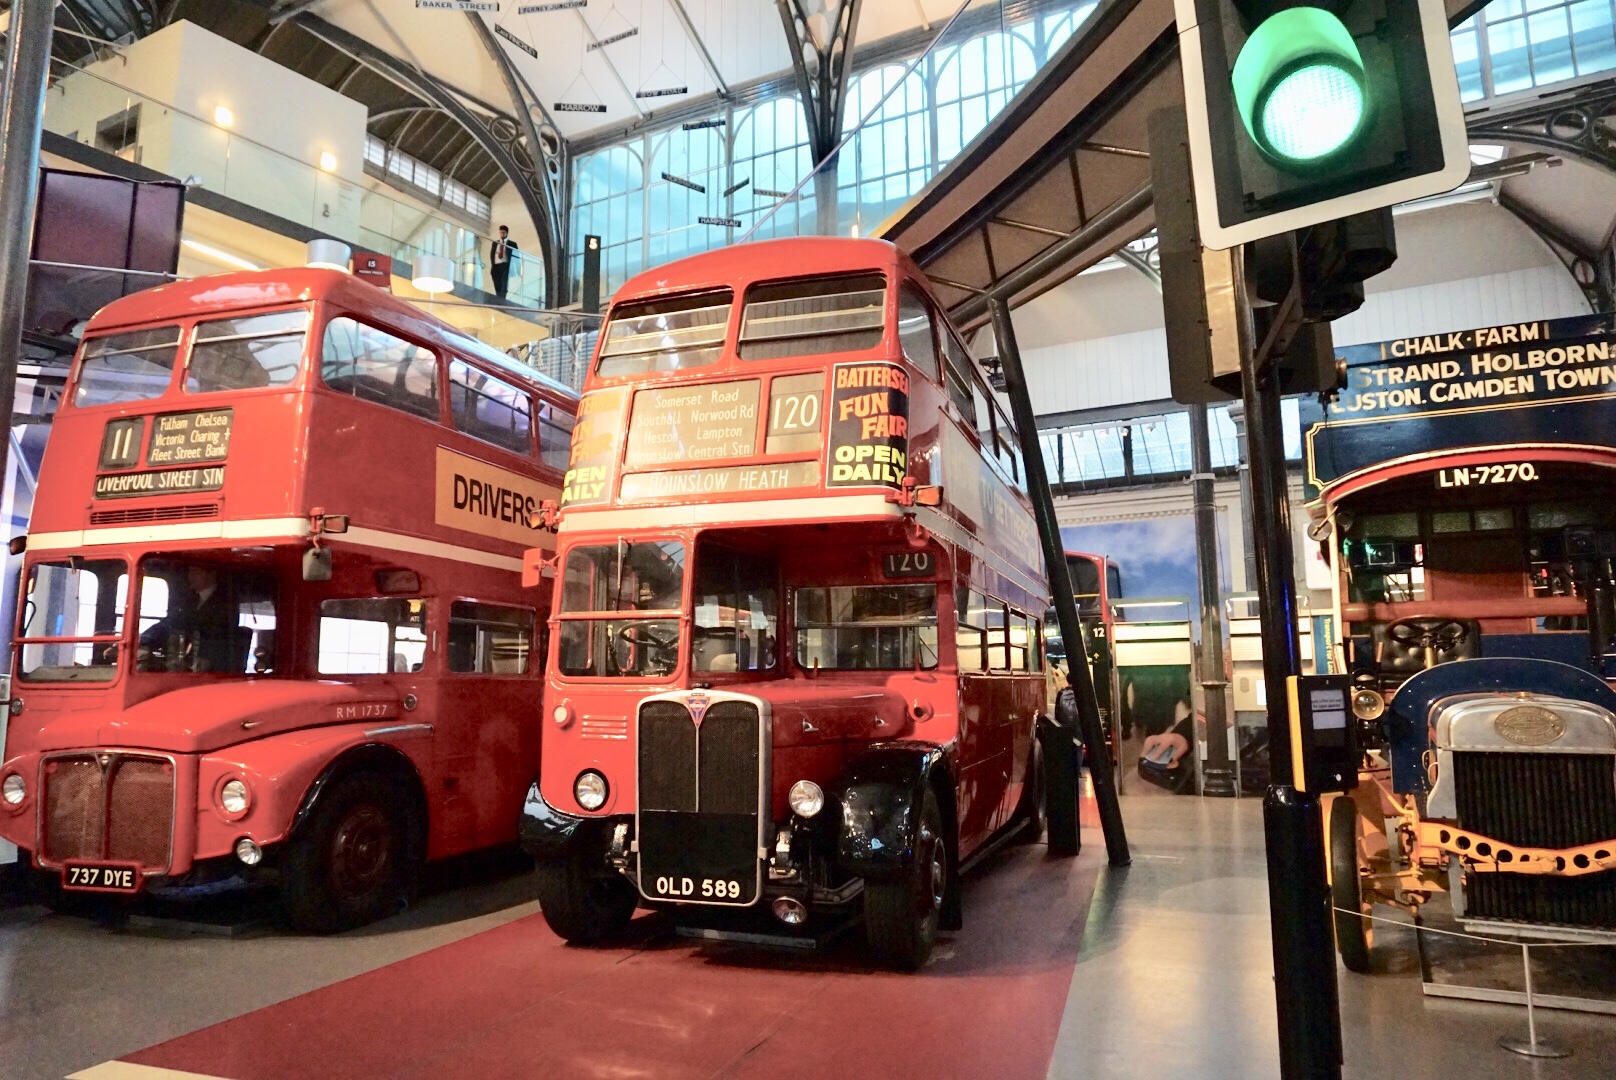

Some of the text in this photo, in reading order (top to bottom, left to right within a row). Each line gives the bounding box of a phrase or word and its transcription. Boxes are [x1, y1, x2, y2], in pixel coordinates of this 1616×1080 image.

[422, 0, 492, 10] BAKER STREET
[550, 0, 584, 10] JUNCTION
[661, 88, 683, 96] ROAD
[560, 103, 600, 112] HARROW
[700, 217, 739, 227] HAMPSTEAD
[589, 238, 598, 250] 5
[368, 260, 376, 268] 15
[1391, 322, 1539, 357] CHALK FARM
[1358, 341, 1616, 388] STRAND. HOLBORN.
[1430, 375, 1534, 402] CAMDEN
[1541, 364, 1616, 391] TOWN
[655, 388, 740, 409] Somerset Road
[839, 392, 889, 422] FUN
[637, 404, 754, 427] Southall Norwood Rd
[773, 394, 818, 430] 120
[160, 414, 227, 431] Fulham Chelsea
[861, 414, 907, 440] FAIR
[111, 427, 132, 460] 11
[155, 433, 185, 446] Victoria
[190, 429, 219, 444] Charing
[643, 426, 743, 445] Heston Lampton
[150, 443, 226, 462] Fleet Street Bank
[688, 443, 727, 459] Central
[731, 441, 750, 456] Stn
[835, 444, 905, 469] OPEN
[96, 467, 224, 492] LIVERPOOL STREET STN
[650, 469, 789, 493] HOUNSLOW HEATH
[832, 463, 905, 486] DAILY
[454, 473, 536, 529] DRIVERS
[889, 552, 928, 572] 120
[1093, 627, 1105, 638] 12
[1324, 617, 1332, 650] Transport
[336, 704, 388, 718] RM 1737
[70, 867, 132, 887] 737 DYE
[656, 876, 740, 898] OLD 589
